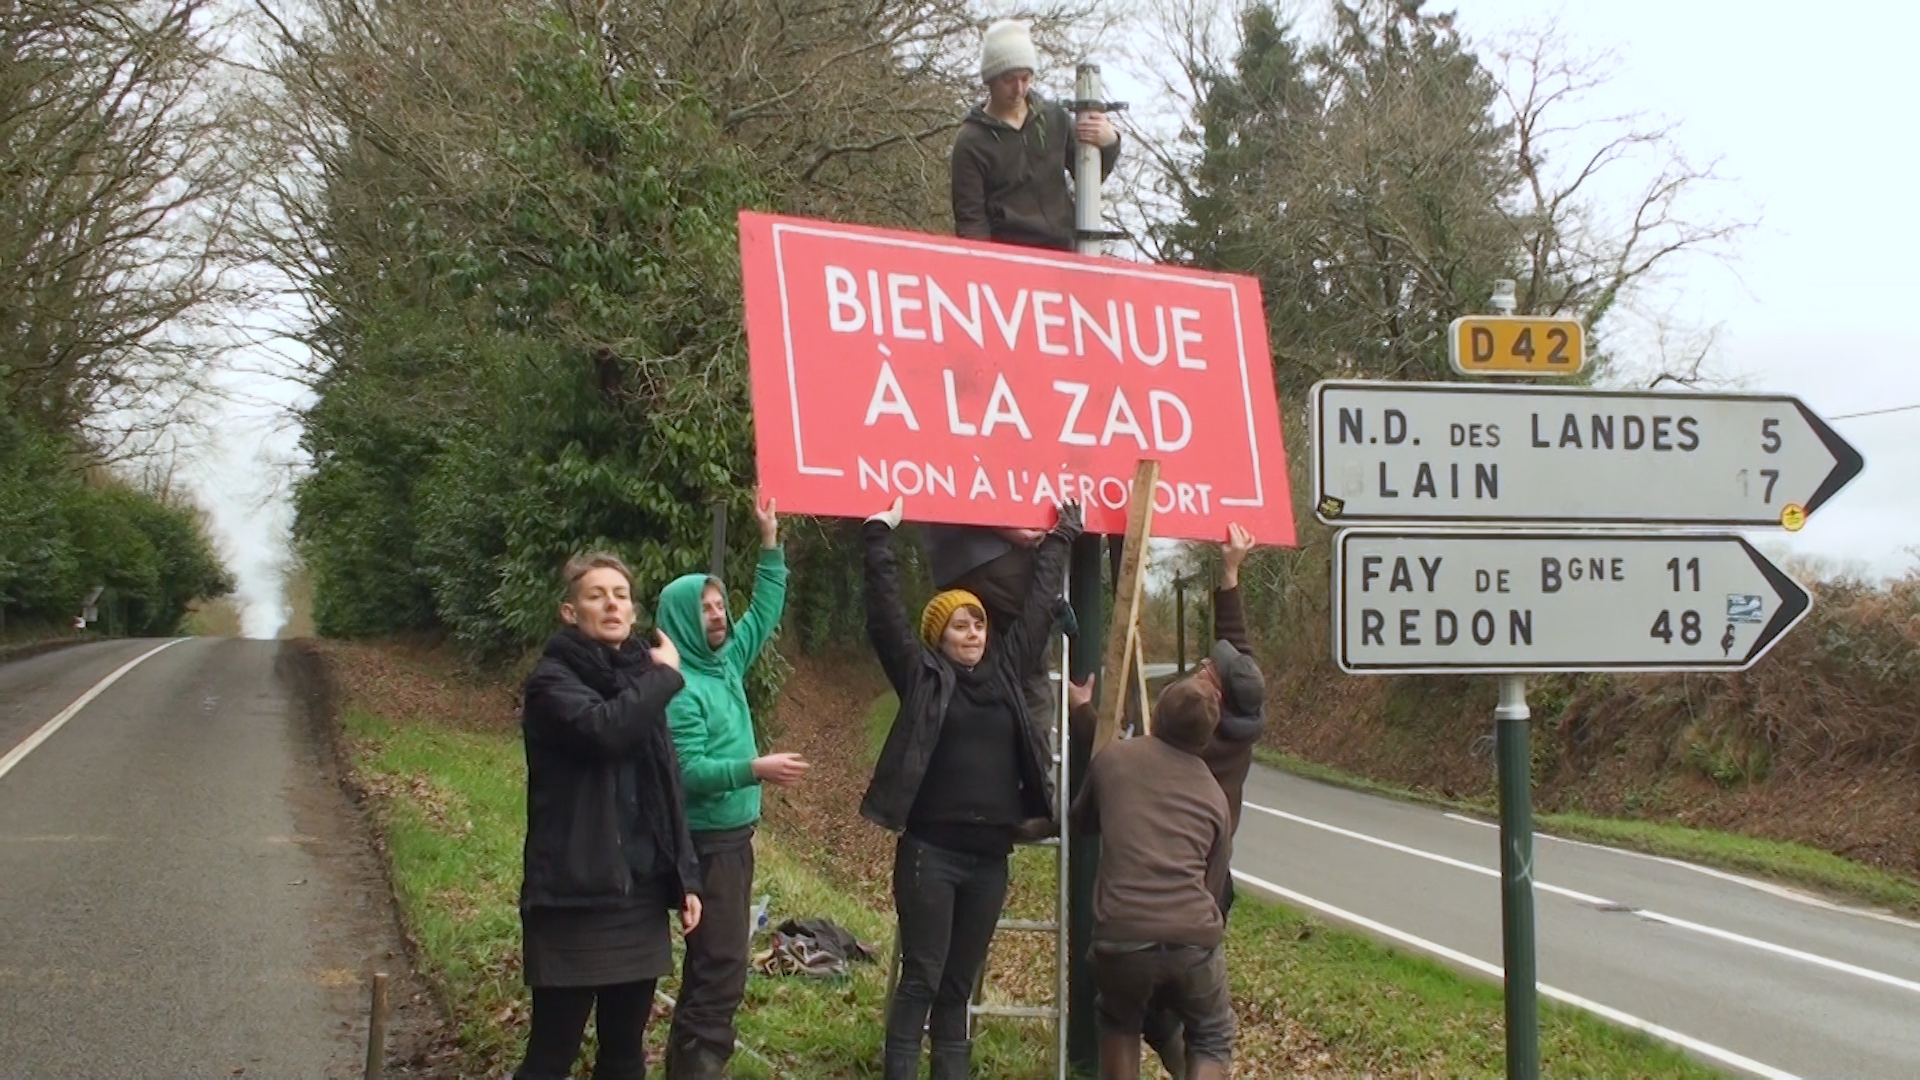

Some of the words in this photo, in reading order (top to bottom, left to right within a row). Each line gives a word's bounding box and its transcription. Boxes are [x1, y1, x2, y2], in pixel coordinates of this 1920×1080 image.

[824, 264, 1207, 370] BIENVENUE
[1471, 326, 1494, 363] D
[1511, 327, 1570, 364] 42
[864, 342, 920, 431] À
[942, 369, 1033, 440] LA
[1052, 380, 1193, 453] ZAD
[1339, 407, 1421, 446] N.D.
[1450, 423, 1500, 448] DES
[1531, 413, 1700, 452] LANDES
[1761, 418, 1782, 454] 5
[857, 456, 956, 498] NON
[969, 455, 997, 500] À
[1007, 463, 1213, 515] L'AÉROORT
[1362, 555, 1443, 593] FAY
[1475, 569, 1511, 594] DE
[1666, 557, 1700, 593] 11
[1361, 608, 1533, 647] REDON
[1650, 609, 1702, 646] 48
